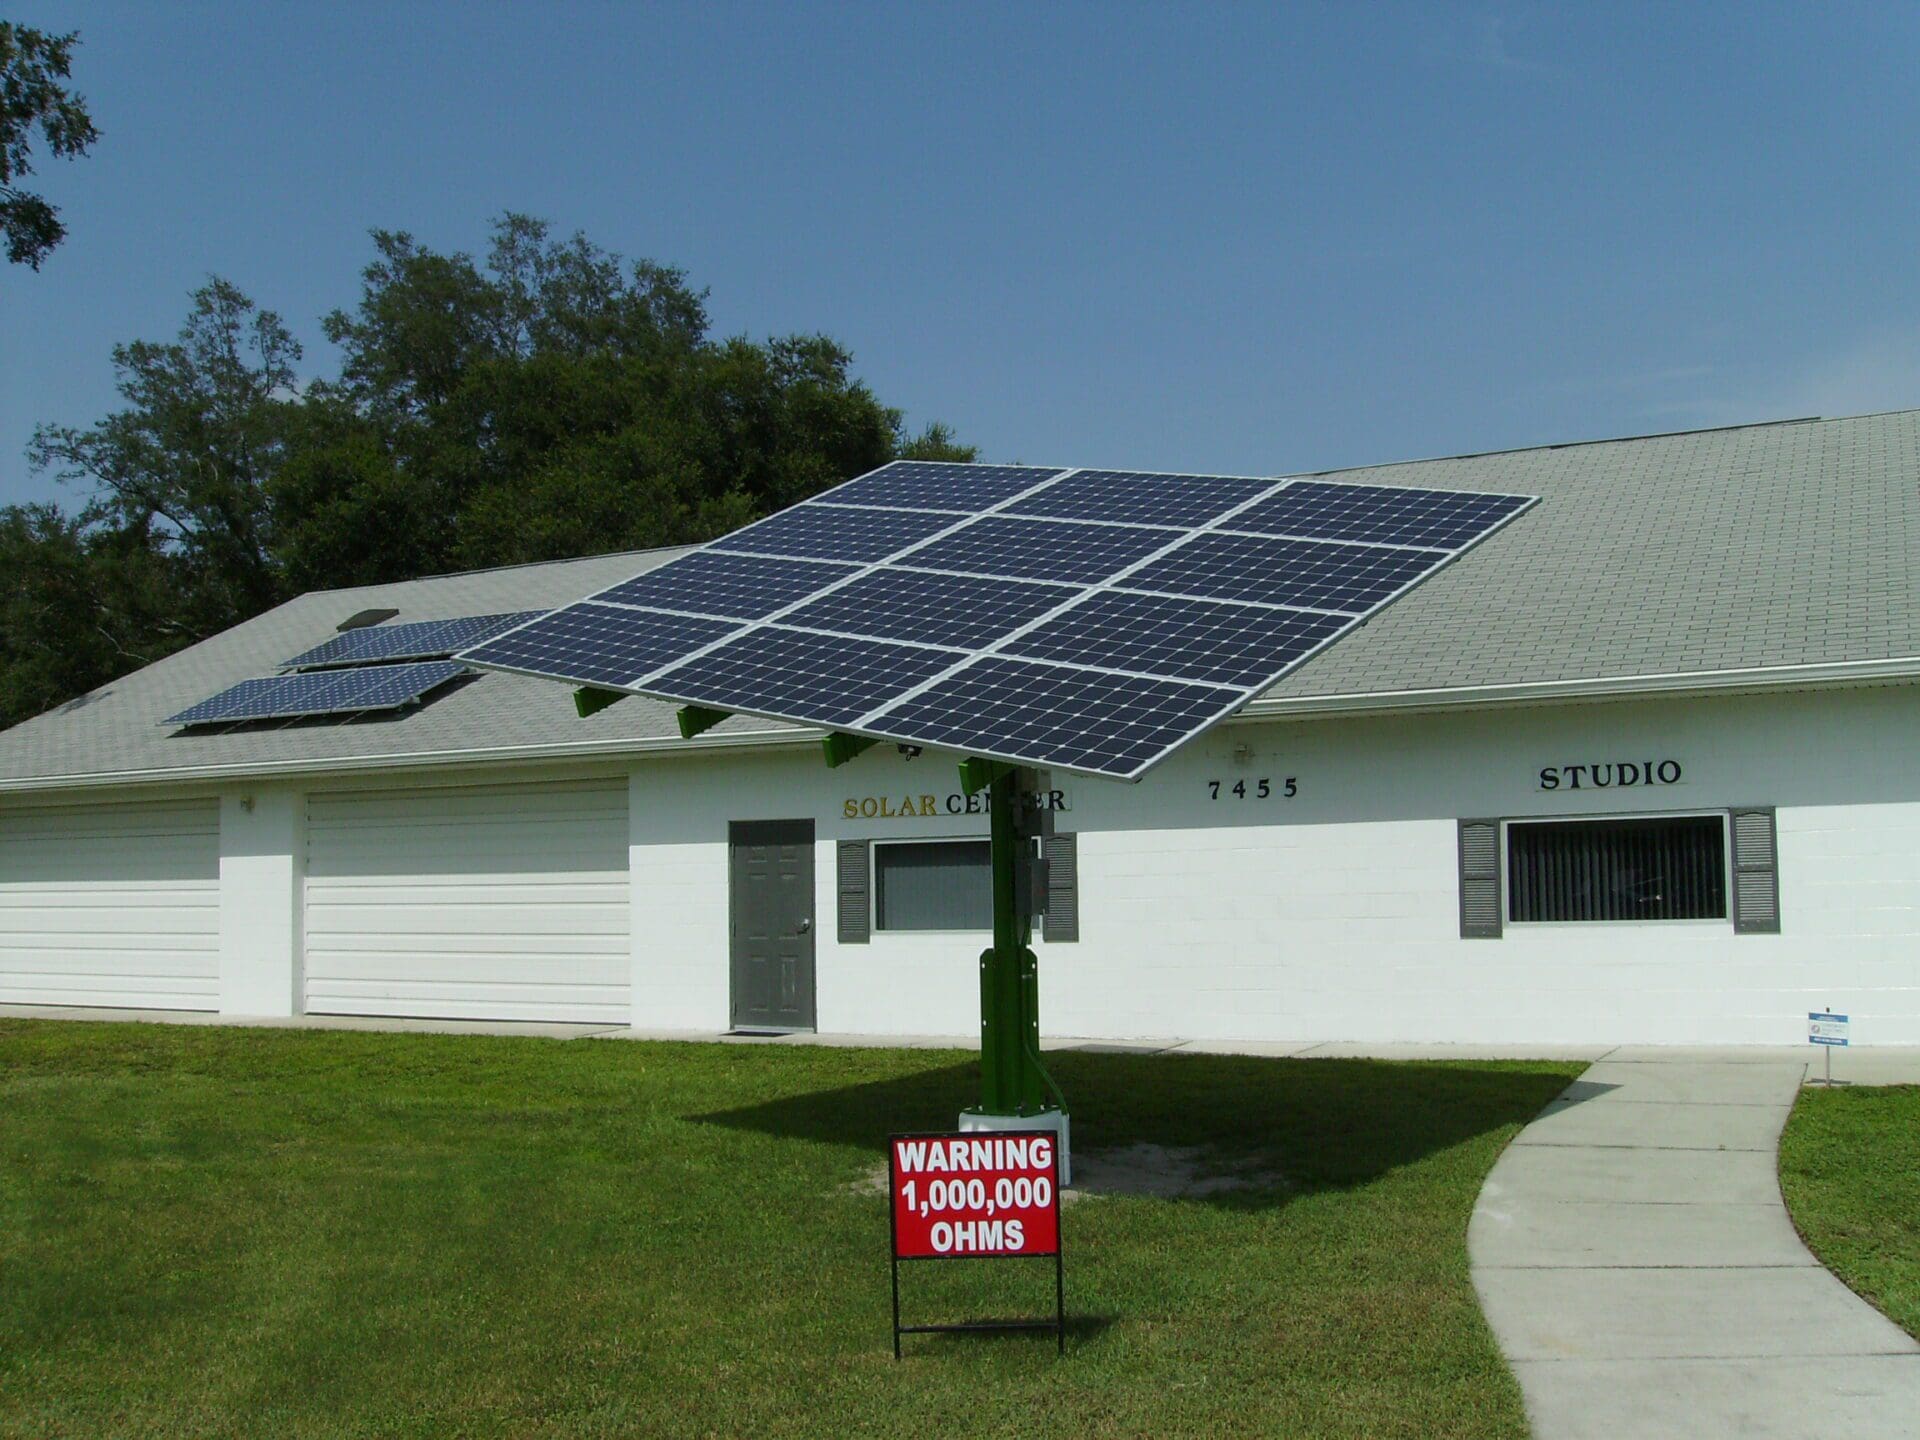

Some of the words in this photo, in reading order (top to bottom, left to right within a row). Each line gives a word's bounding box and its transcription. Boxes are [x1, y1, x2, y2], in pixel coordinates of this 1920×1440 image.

[1208, 778, 1297, 800] 7455
[1540, 760, 1682, 790] STUDIO
[843, 795, 937, 817] SOLAR
[945, 790, 1066, 814] CEER
[897, 1138, 1052, 1173] WARNING
[901, 1176, 1051, 1218] 1,000,000
[930, 1219, 1025, 1252] OHMS
